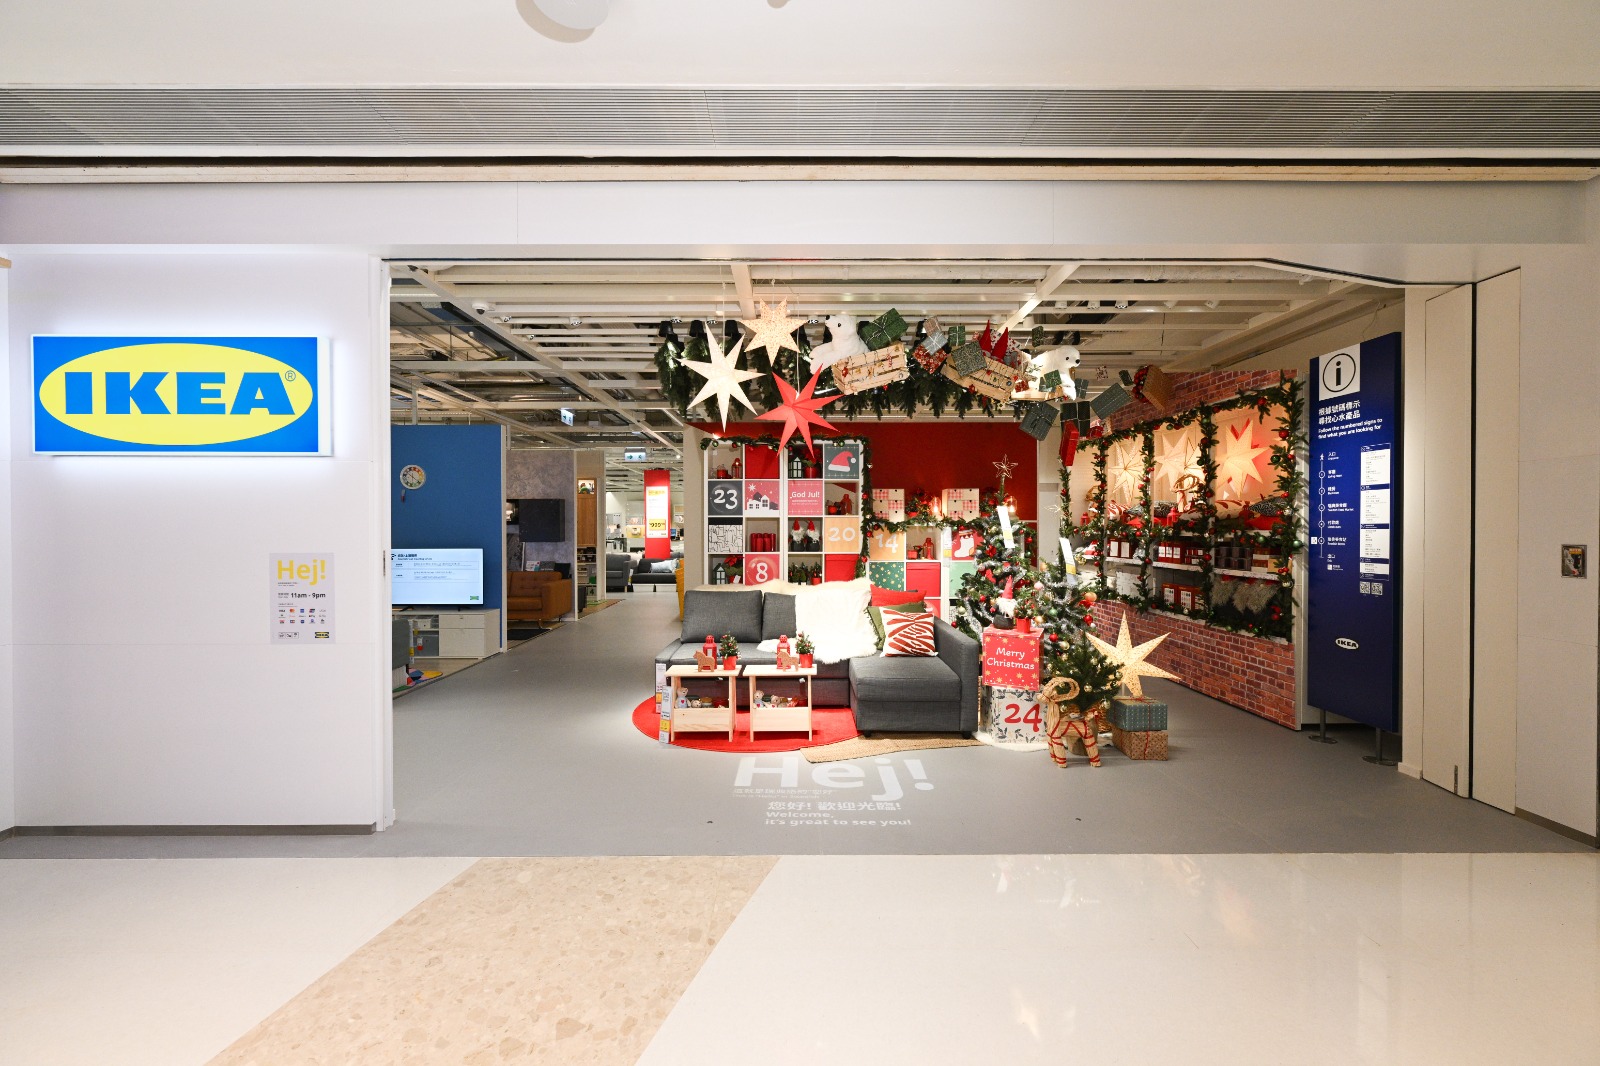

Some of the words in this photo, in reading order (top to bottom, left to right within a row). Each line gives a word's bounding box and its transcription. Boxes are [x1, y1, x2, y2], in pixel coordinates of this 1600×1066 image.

[714, 489, 738, 510] 23
[828, 528, 856, 542] 20
[876, 532, 899, 554] 14
[277, 559, 326, 585] Hej!
[756, 563, 768, 583] 8
[996, 647, 1025, 660] Merry
[1338, 640, 1357, 648] IKEA
[987, 658, 1034, 670] Christmas
[1004, 703, 1042, 732] 24
[734, 756, 934, 801] Hej!
